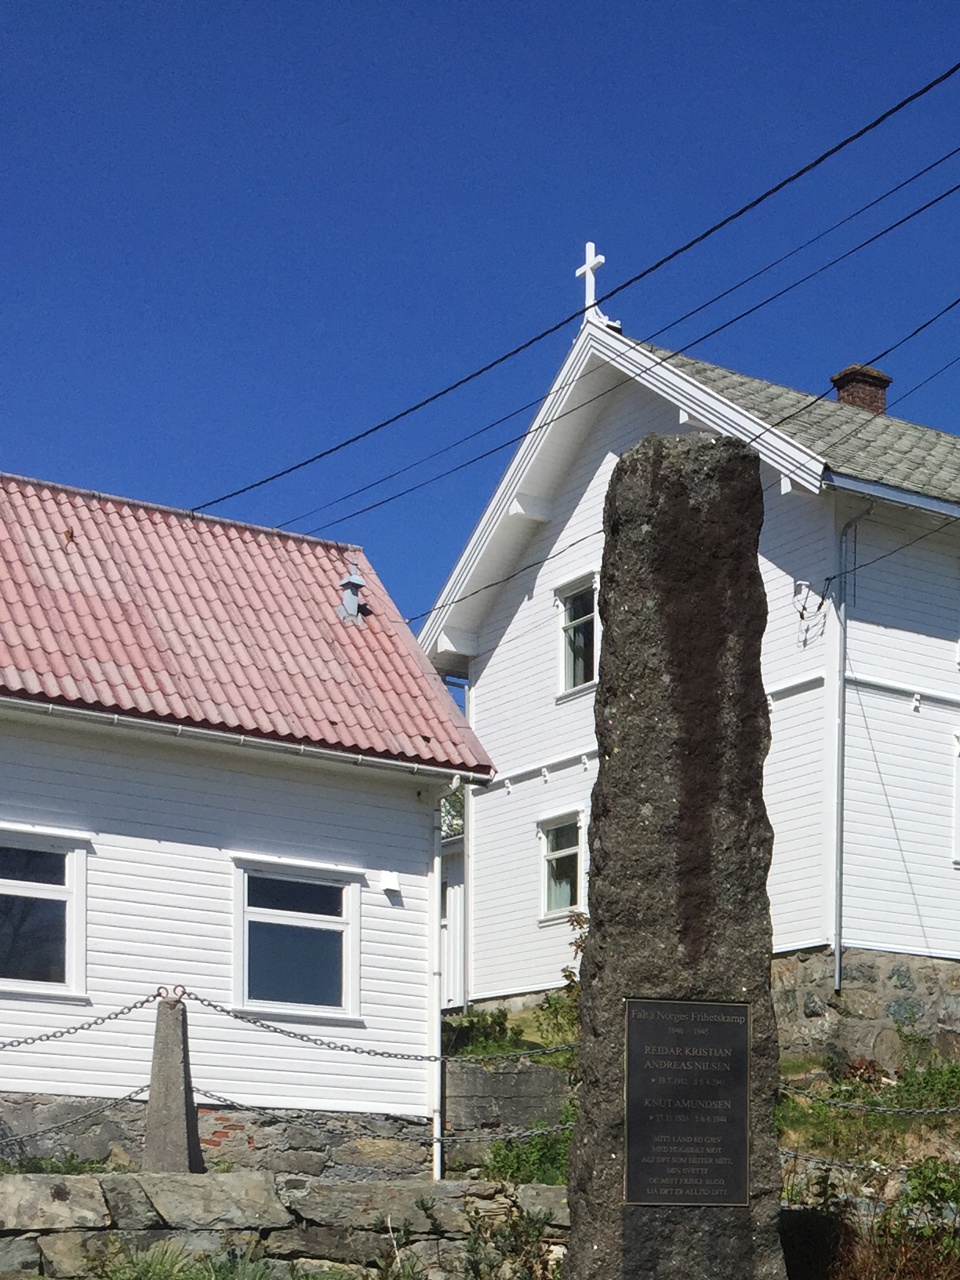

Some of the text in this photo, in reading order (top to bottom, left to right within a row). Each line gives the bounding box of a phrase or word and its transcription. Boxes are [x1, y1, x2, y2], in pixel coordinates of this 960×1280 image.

[657, 1010, 688, 1022] Norges
[690, 1012, 746, 1024] Frihetskamp
[644, 1045, 732, 1057] REIDAR KRISTIAN
[644, 1060, 731, 1071] ANDREAS NILSEN
[644, 1098, 732, 1109] KNUT AMUNDSEN
